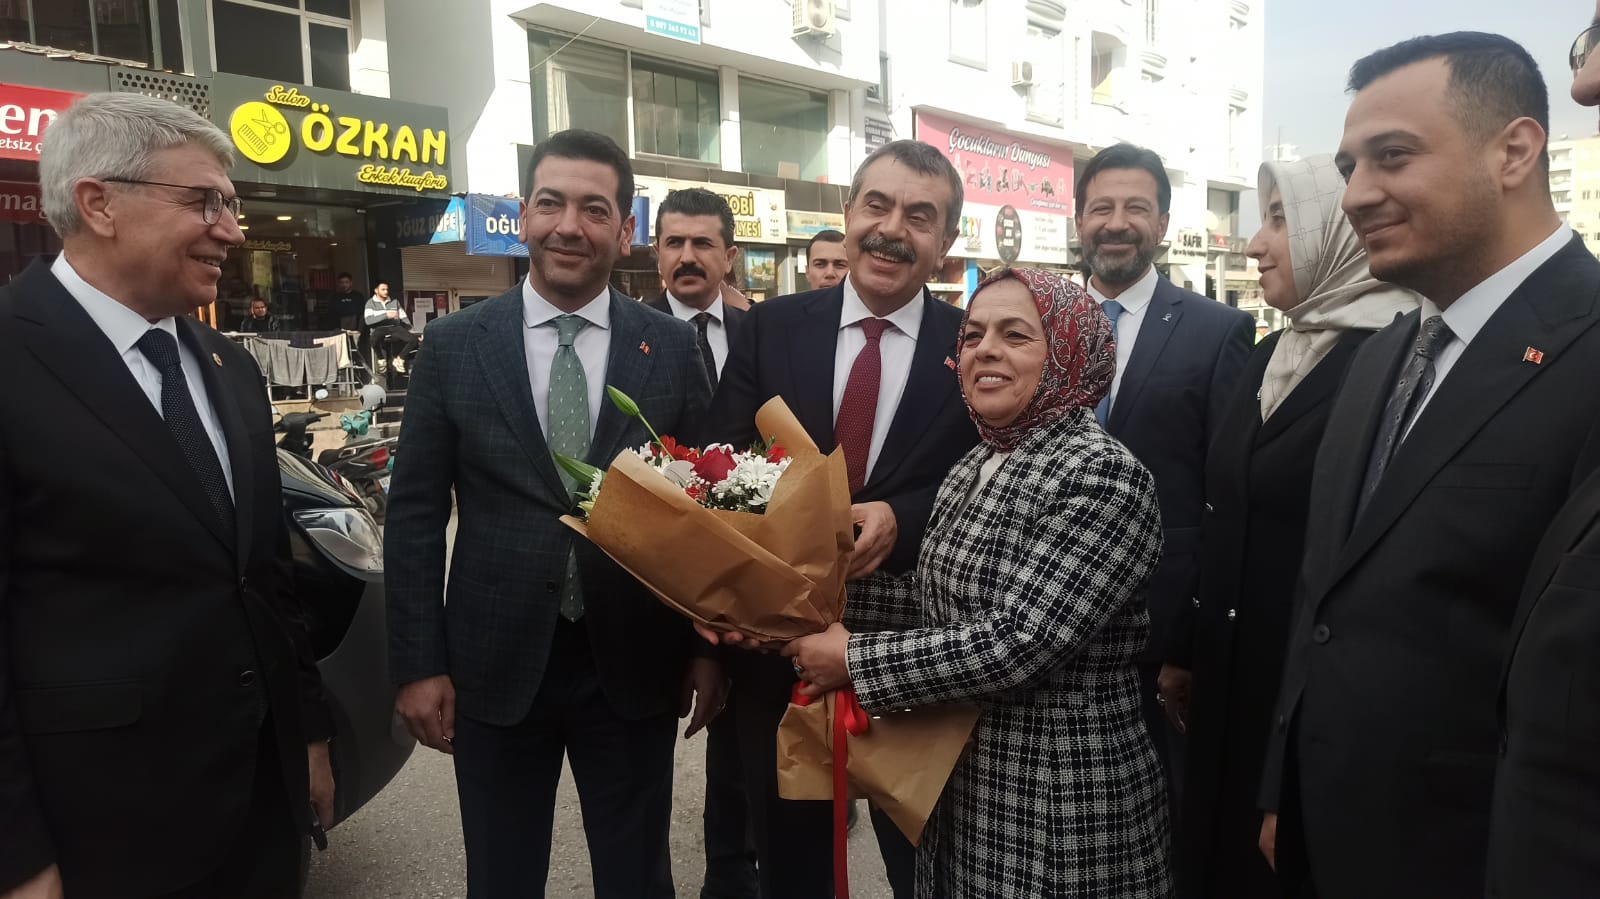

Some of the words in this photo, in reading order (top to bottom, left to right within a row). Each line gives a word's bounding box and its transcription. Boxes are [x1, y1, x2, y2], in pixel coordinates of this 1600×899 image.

[265, 85, 311, 107] Salon
[302, 102, 446, 165] ÖZKAN
[949, 127, 1009, 159] Çocukların
[1010, 141, 1051, 170] Dünyası
[358, 164, 399, 186] Erkek
[398, 168, 448, 192] kuaförü
[1183, 233, 1202, 248] SAFİR
